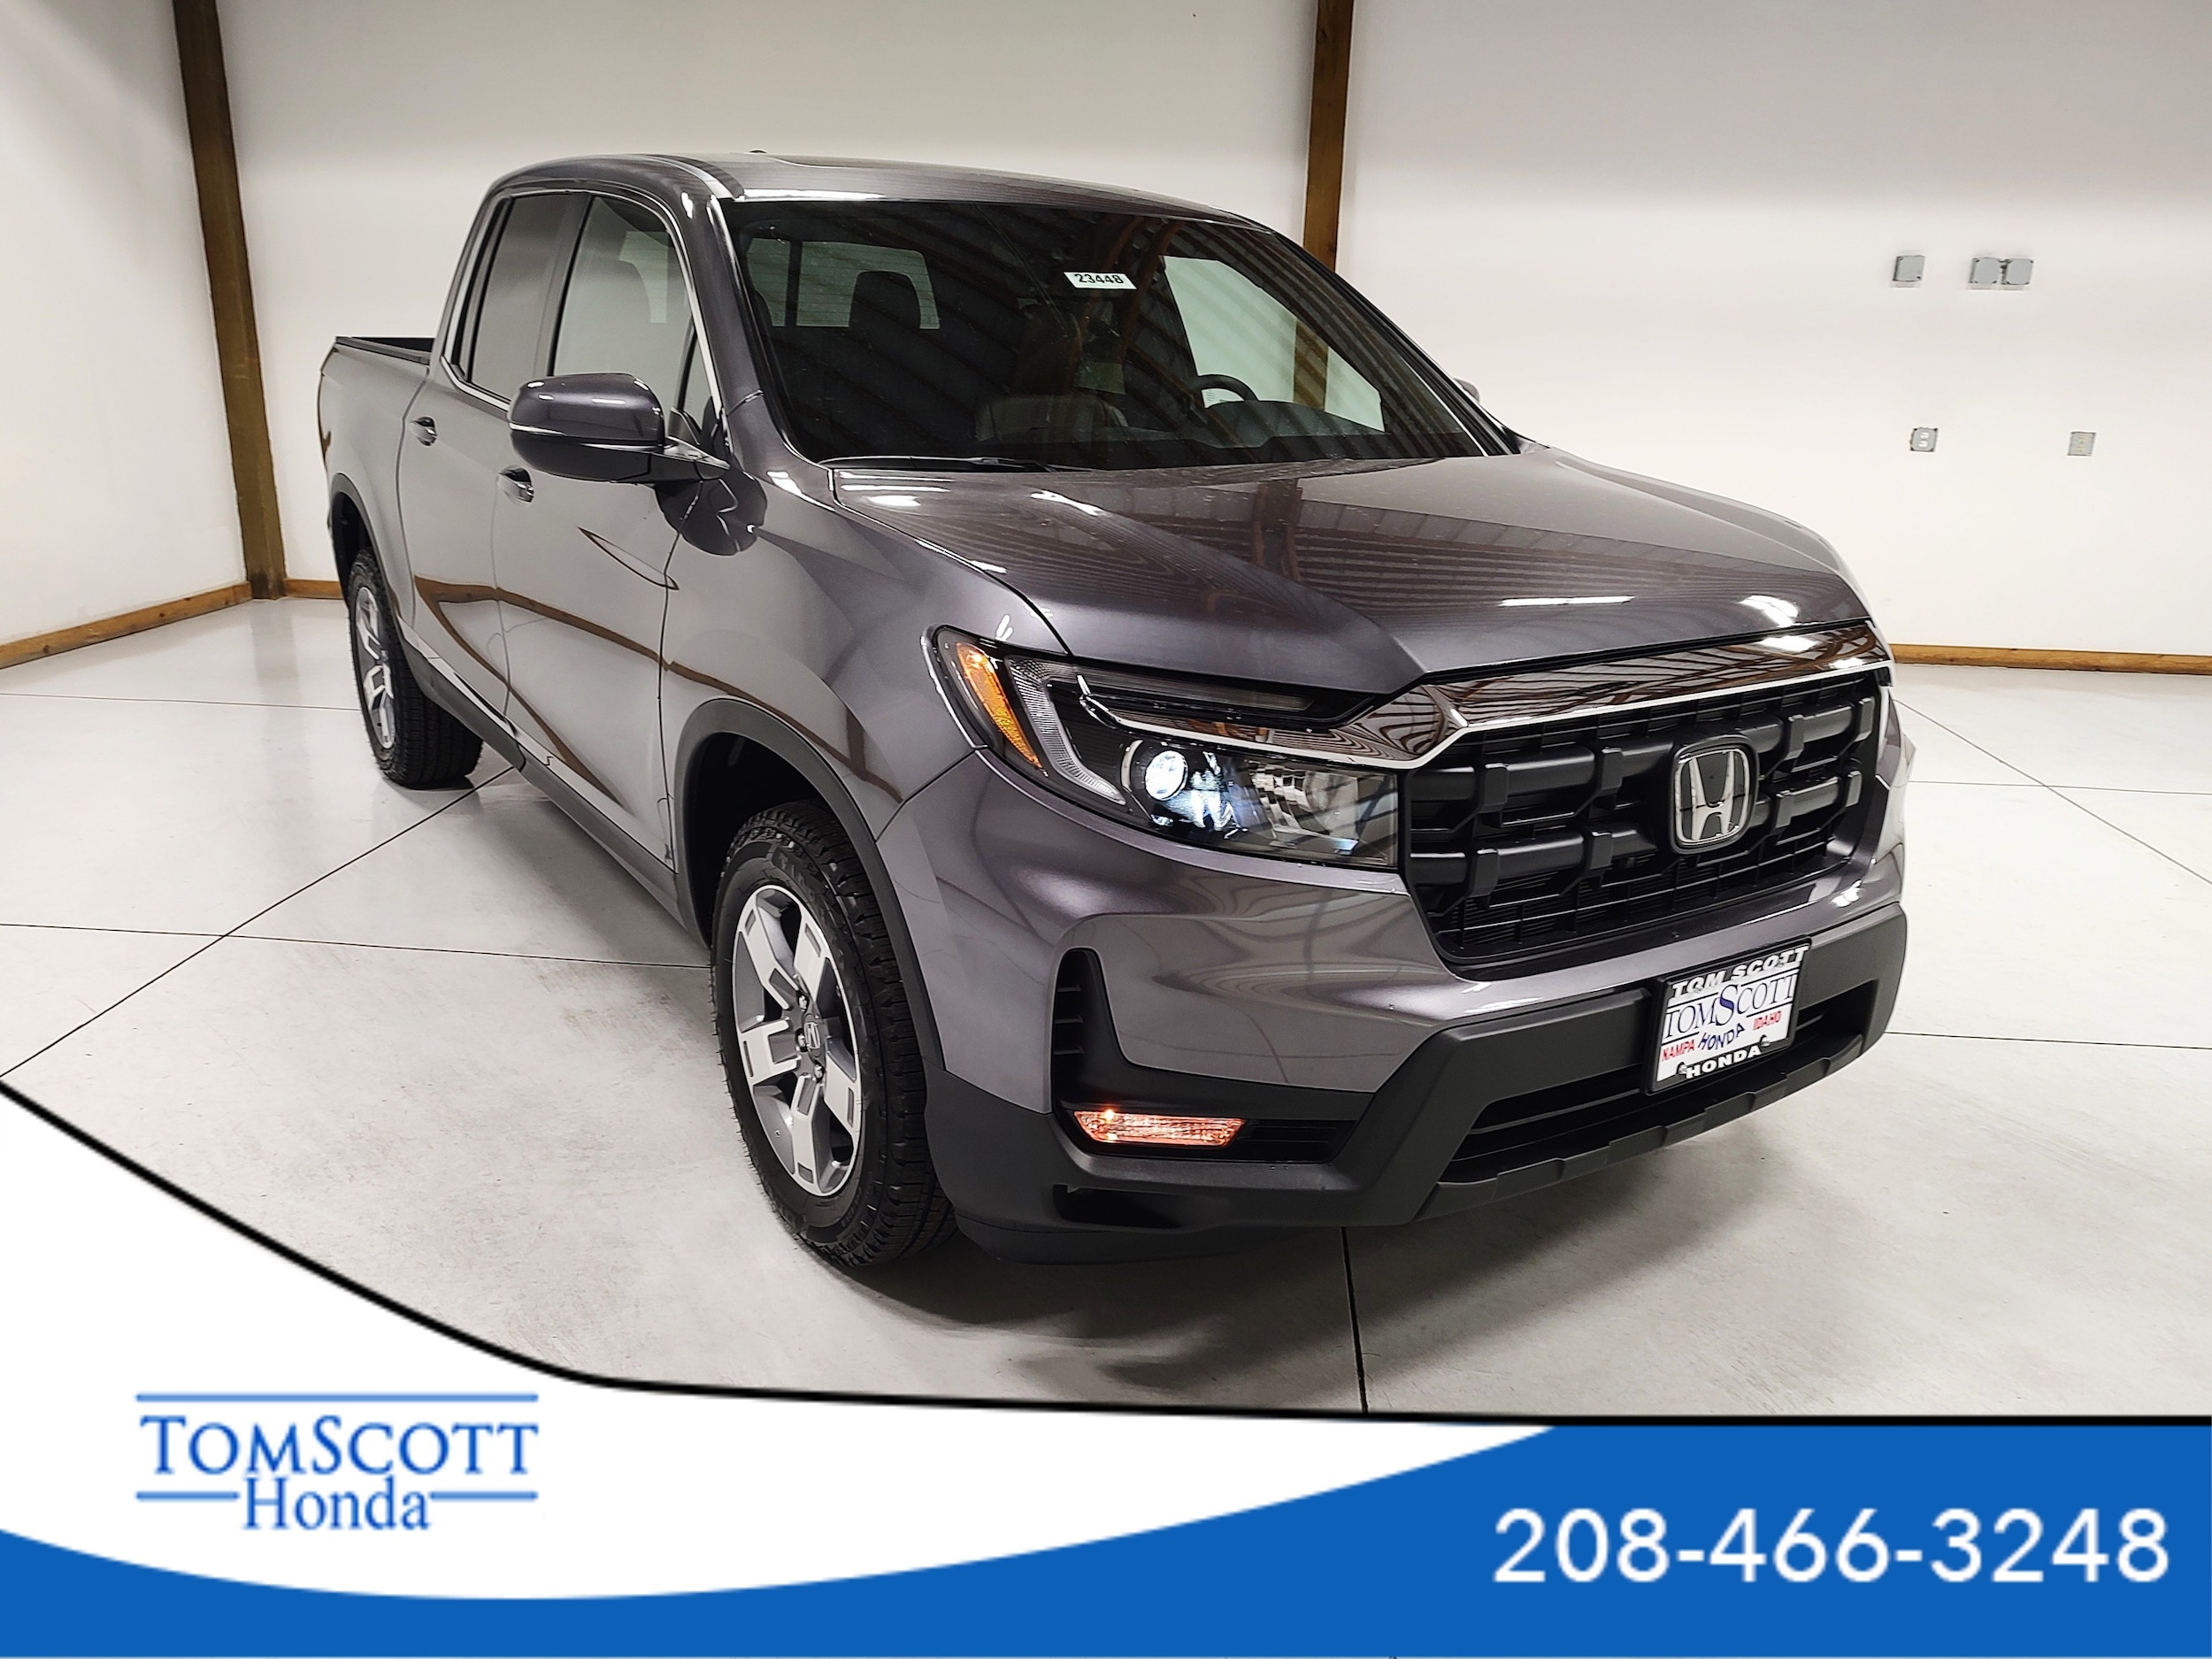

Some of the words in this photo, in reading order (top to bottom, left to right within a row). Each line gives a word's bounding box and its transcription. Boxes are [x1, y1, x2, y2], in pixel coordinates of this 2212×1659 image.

[1073, 273, 1125, 284] 23448
[1671, 970, 1728, 998] TOM
[1731, 946, 1809, 981] SCOTT
[1662, 1039, 1695, 1061] NAMPA
[1697, 1022, 1746, 1050] HONDA
[1752, 1010, 1782, 1031] IDAHO
[1685, 1045, 1763, 1079] HONDA
